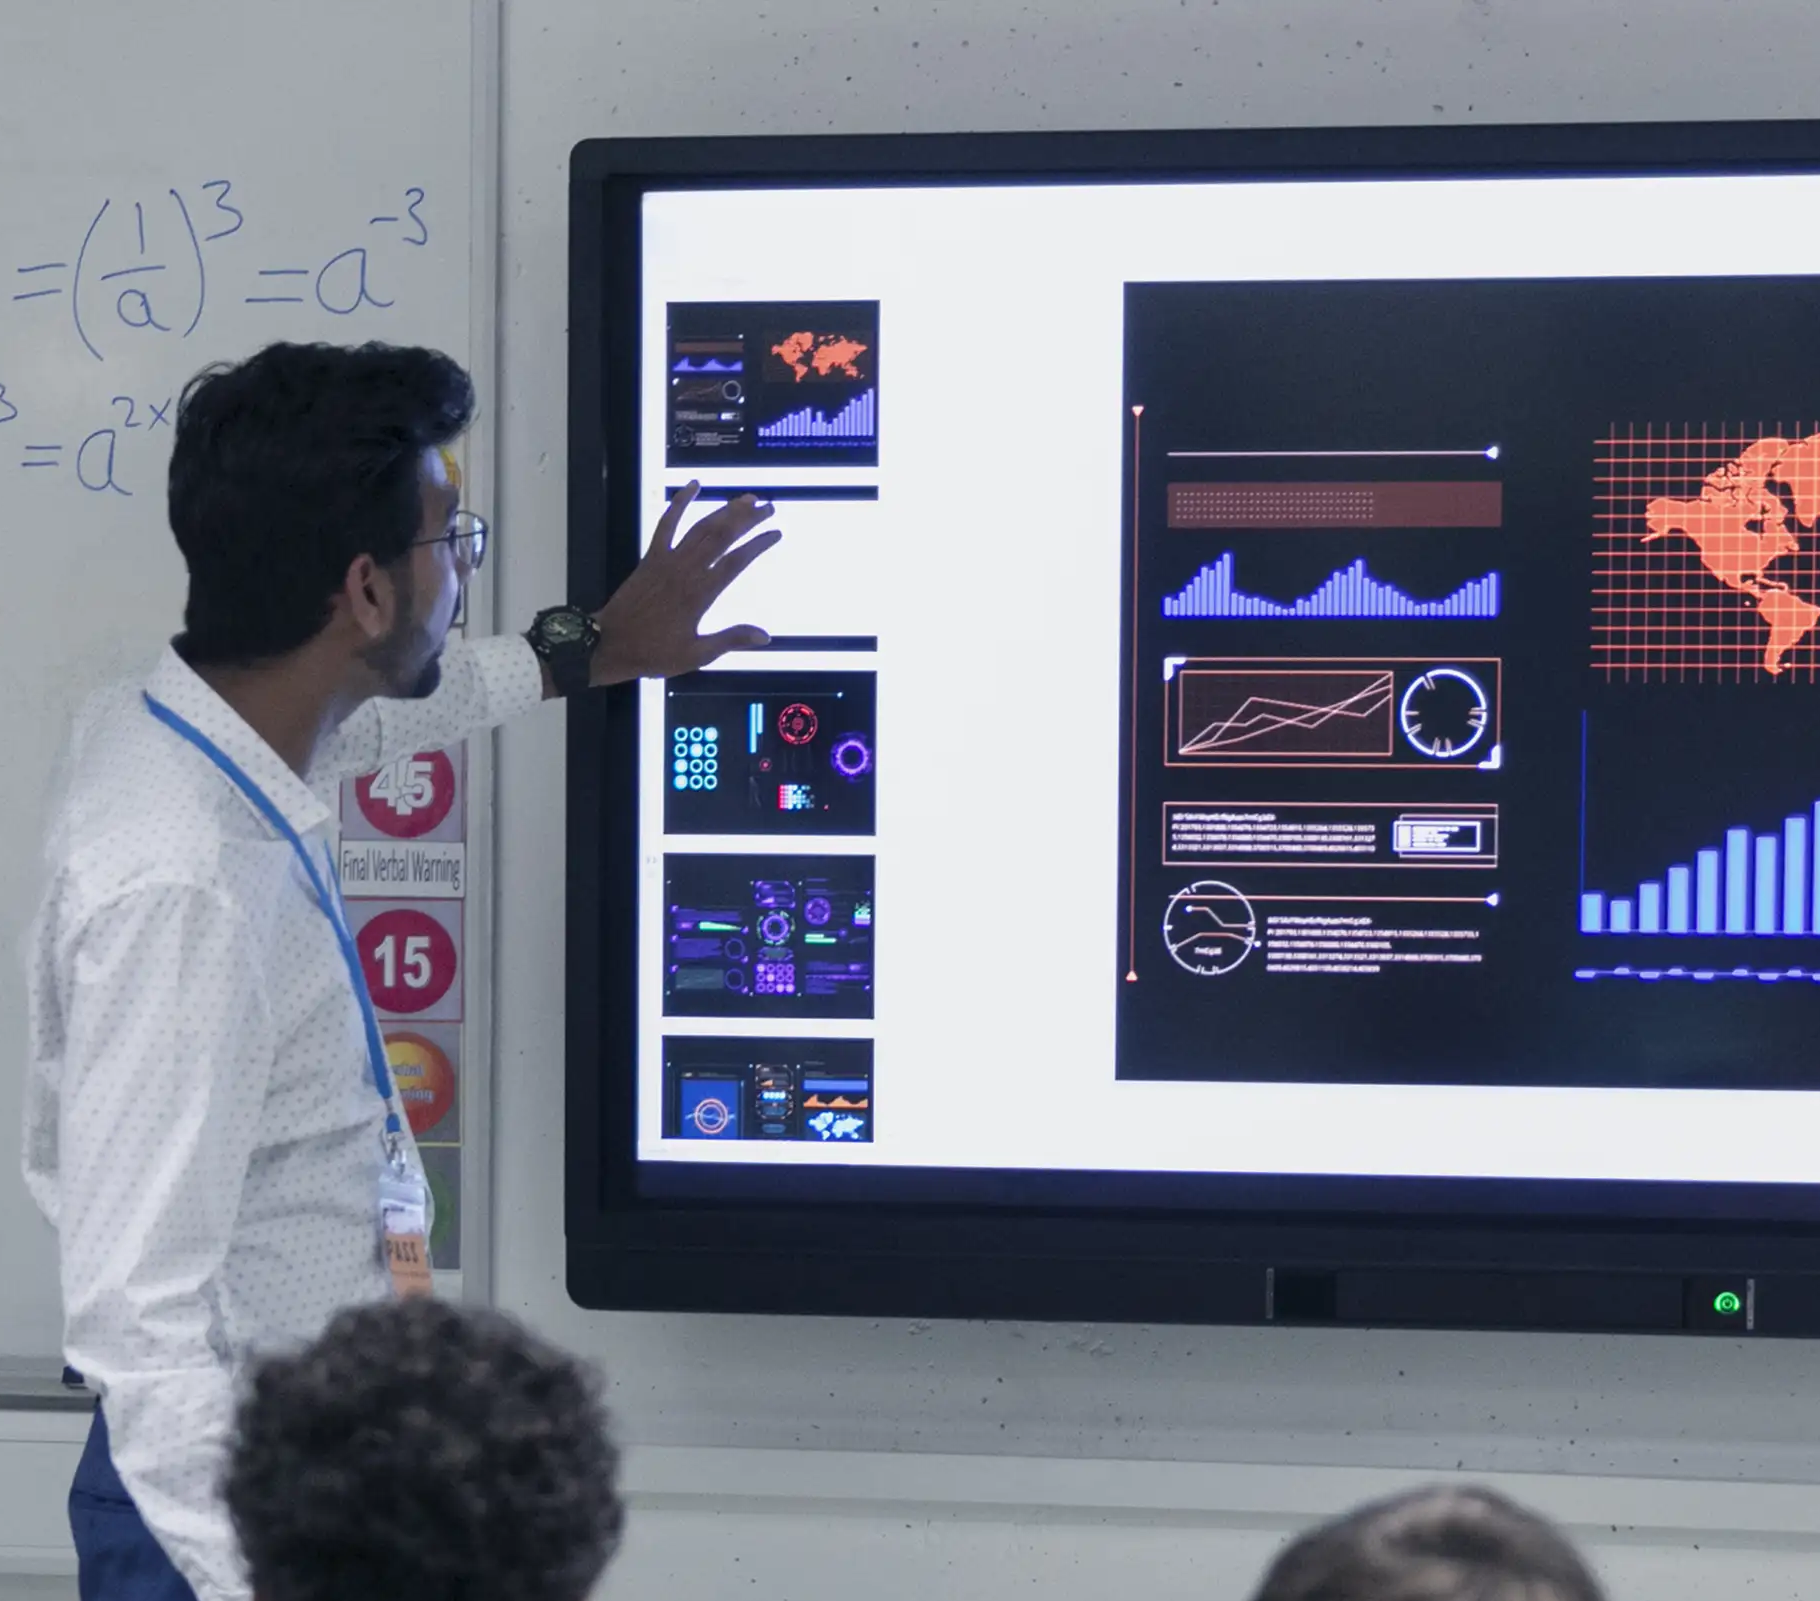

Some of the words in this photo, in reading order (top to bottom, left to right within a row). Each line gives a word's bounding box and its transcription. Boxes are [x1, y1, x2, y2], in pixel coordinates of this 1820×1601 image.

[343, 848, 369, 882] Final
[372, 848, 409, 882] Verbal
[412, 850, 460, 891] Warning
[374, 934, 432, 989] 15
